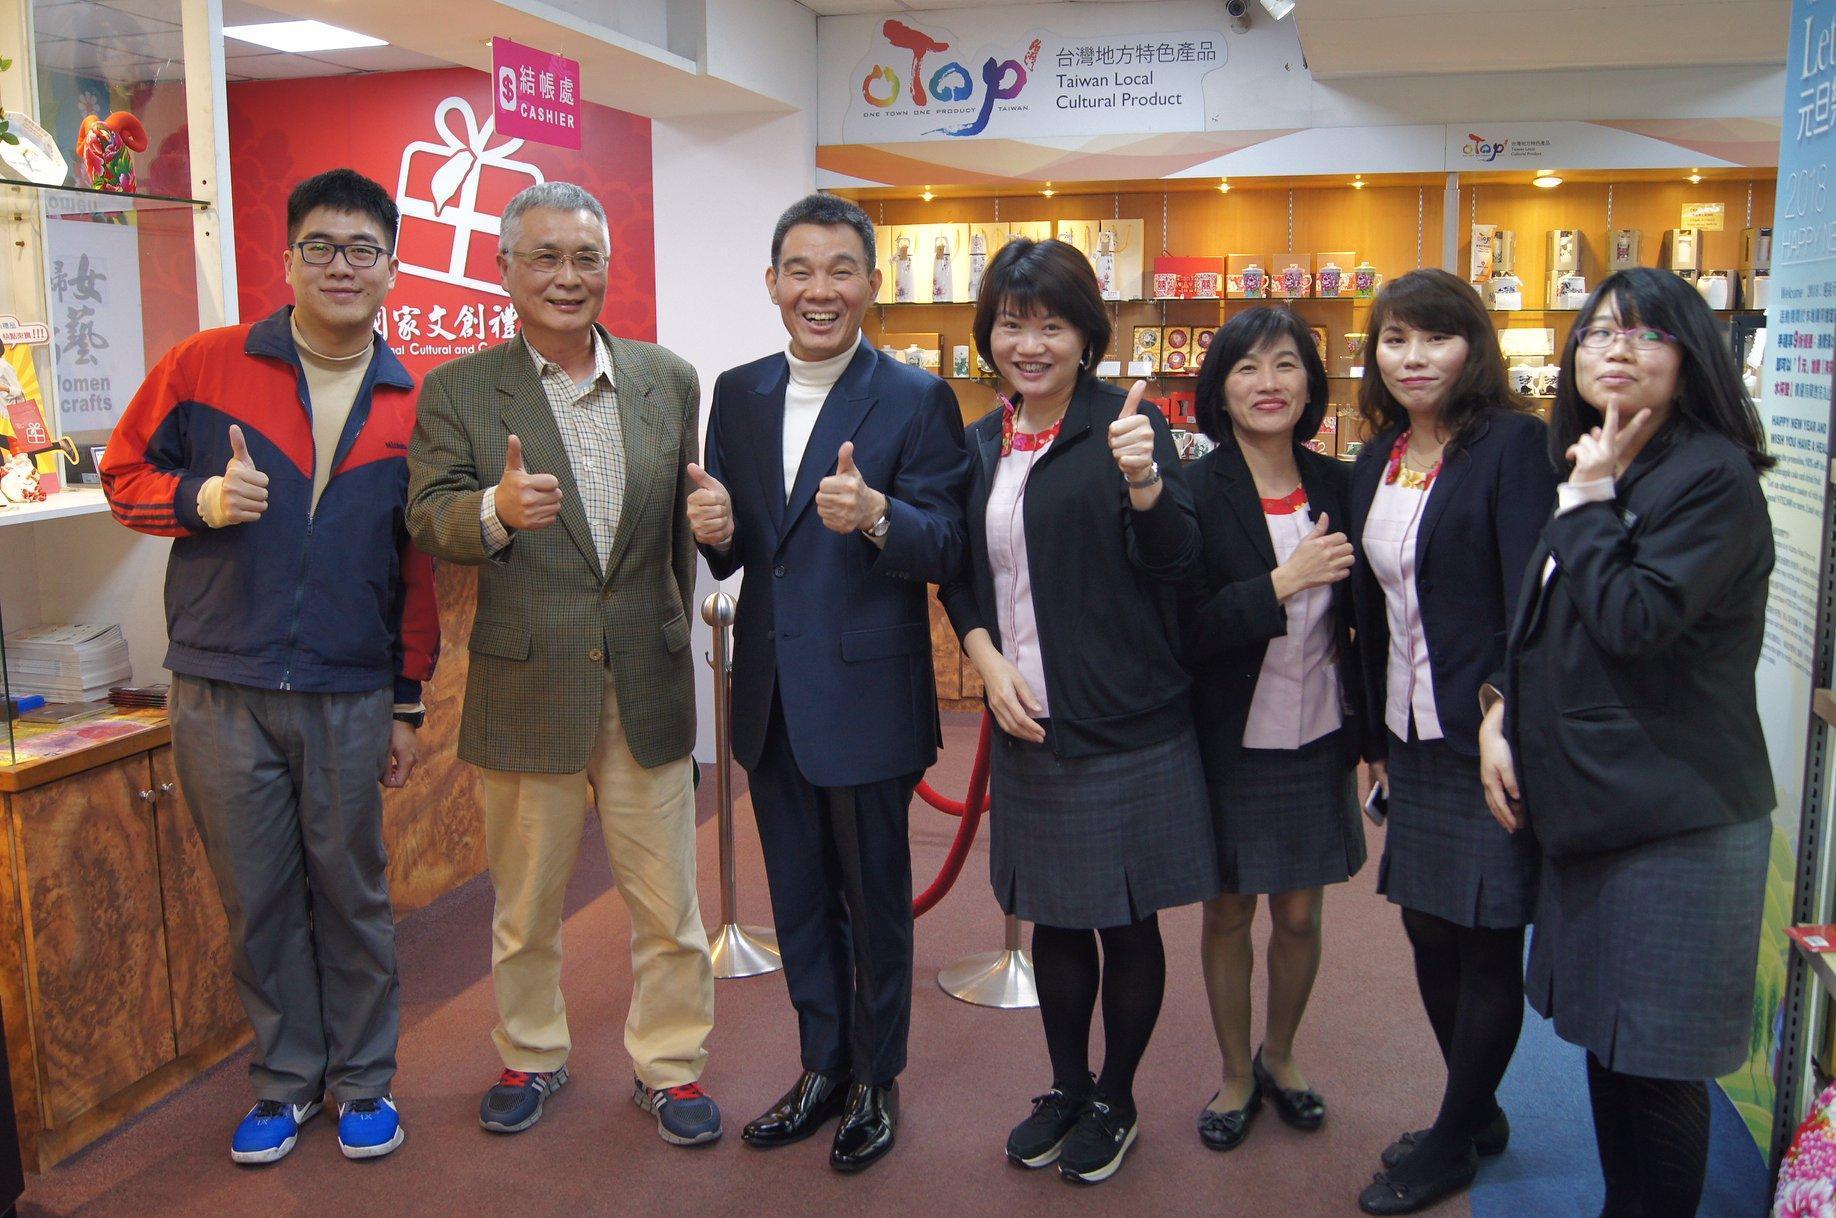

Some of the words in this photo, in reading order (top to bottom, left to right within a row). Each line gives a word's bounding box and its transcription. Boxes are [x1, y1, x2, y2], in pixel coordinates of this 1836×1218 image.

[1056, 41, 1216, 67] 台灣地方特色產品
[520, 65, 574, 106] 結帳處
[1056, 74, 1108, 88] Taiwan
[1115, 70, 1153, 86] Local
[1056, 93, 1116, 109] Cultural
[1122, 91, 1182, 107] Product
[520, 103, 575, 128] CASHIER
[1785, 163, 1828, 220] 2018
[1781, 224, 1820, 258] HAPPY
[410, 342, 451, 355] Cultural
[455, 345, 474, 355] and
[59, 375, 111, 393] omen
[1771, 415, 1789, 427] HAPPY
[1791, 418, 1802, 429] NEW
[1803, 419, 1816, 432] YEAR
[1770, 433, 1784, 446] WISH
[1786, 435, 1797, 448] YOU
[1797, 438, 1811, 450] HAVE
